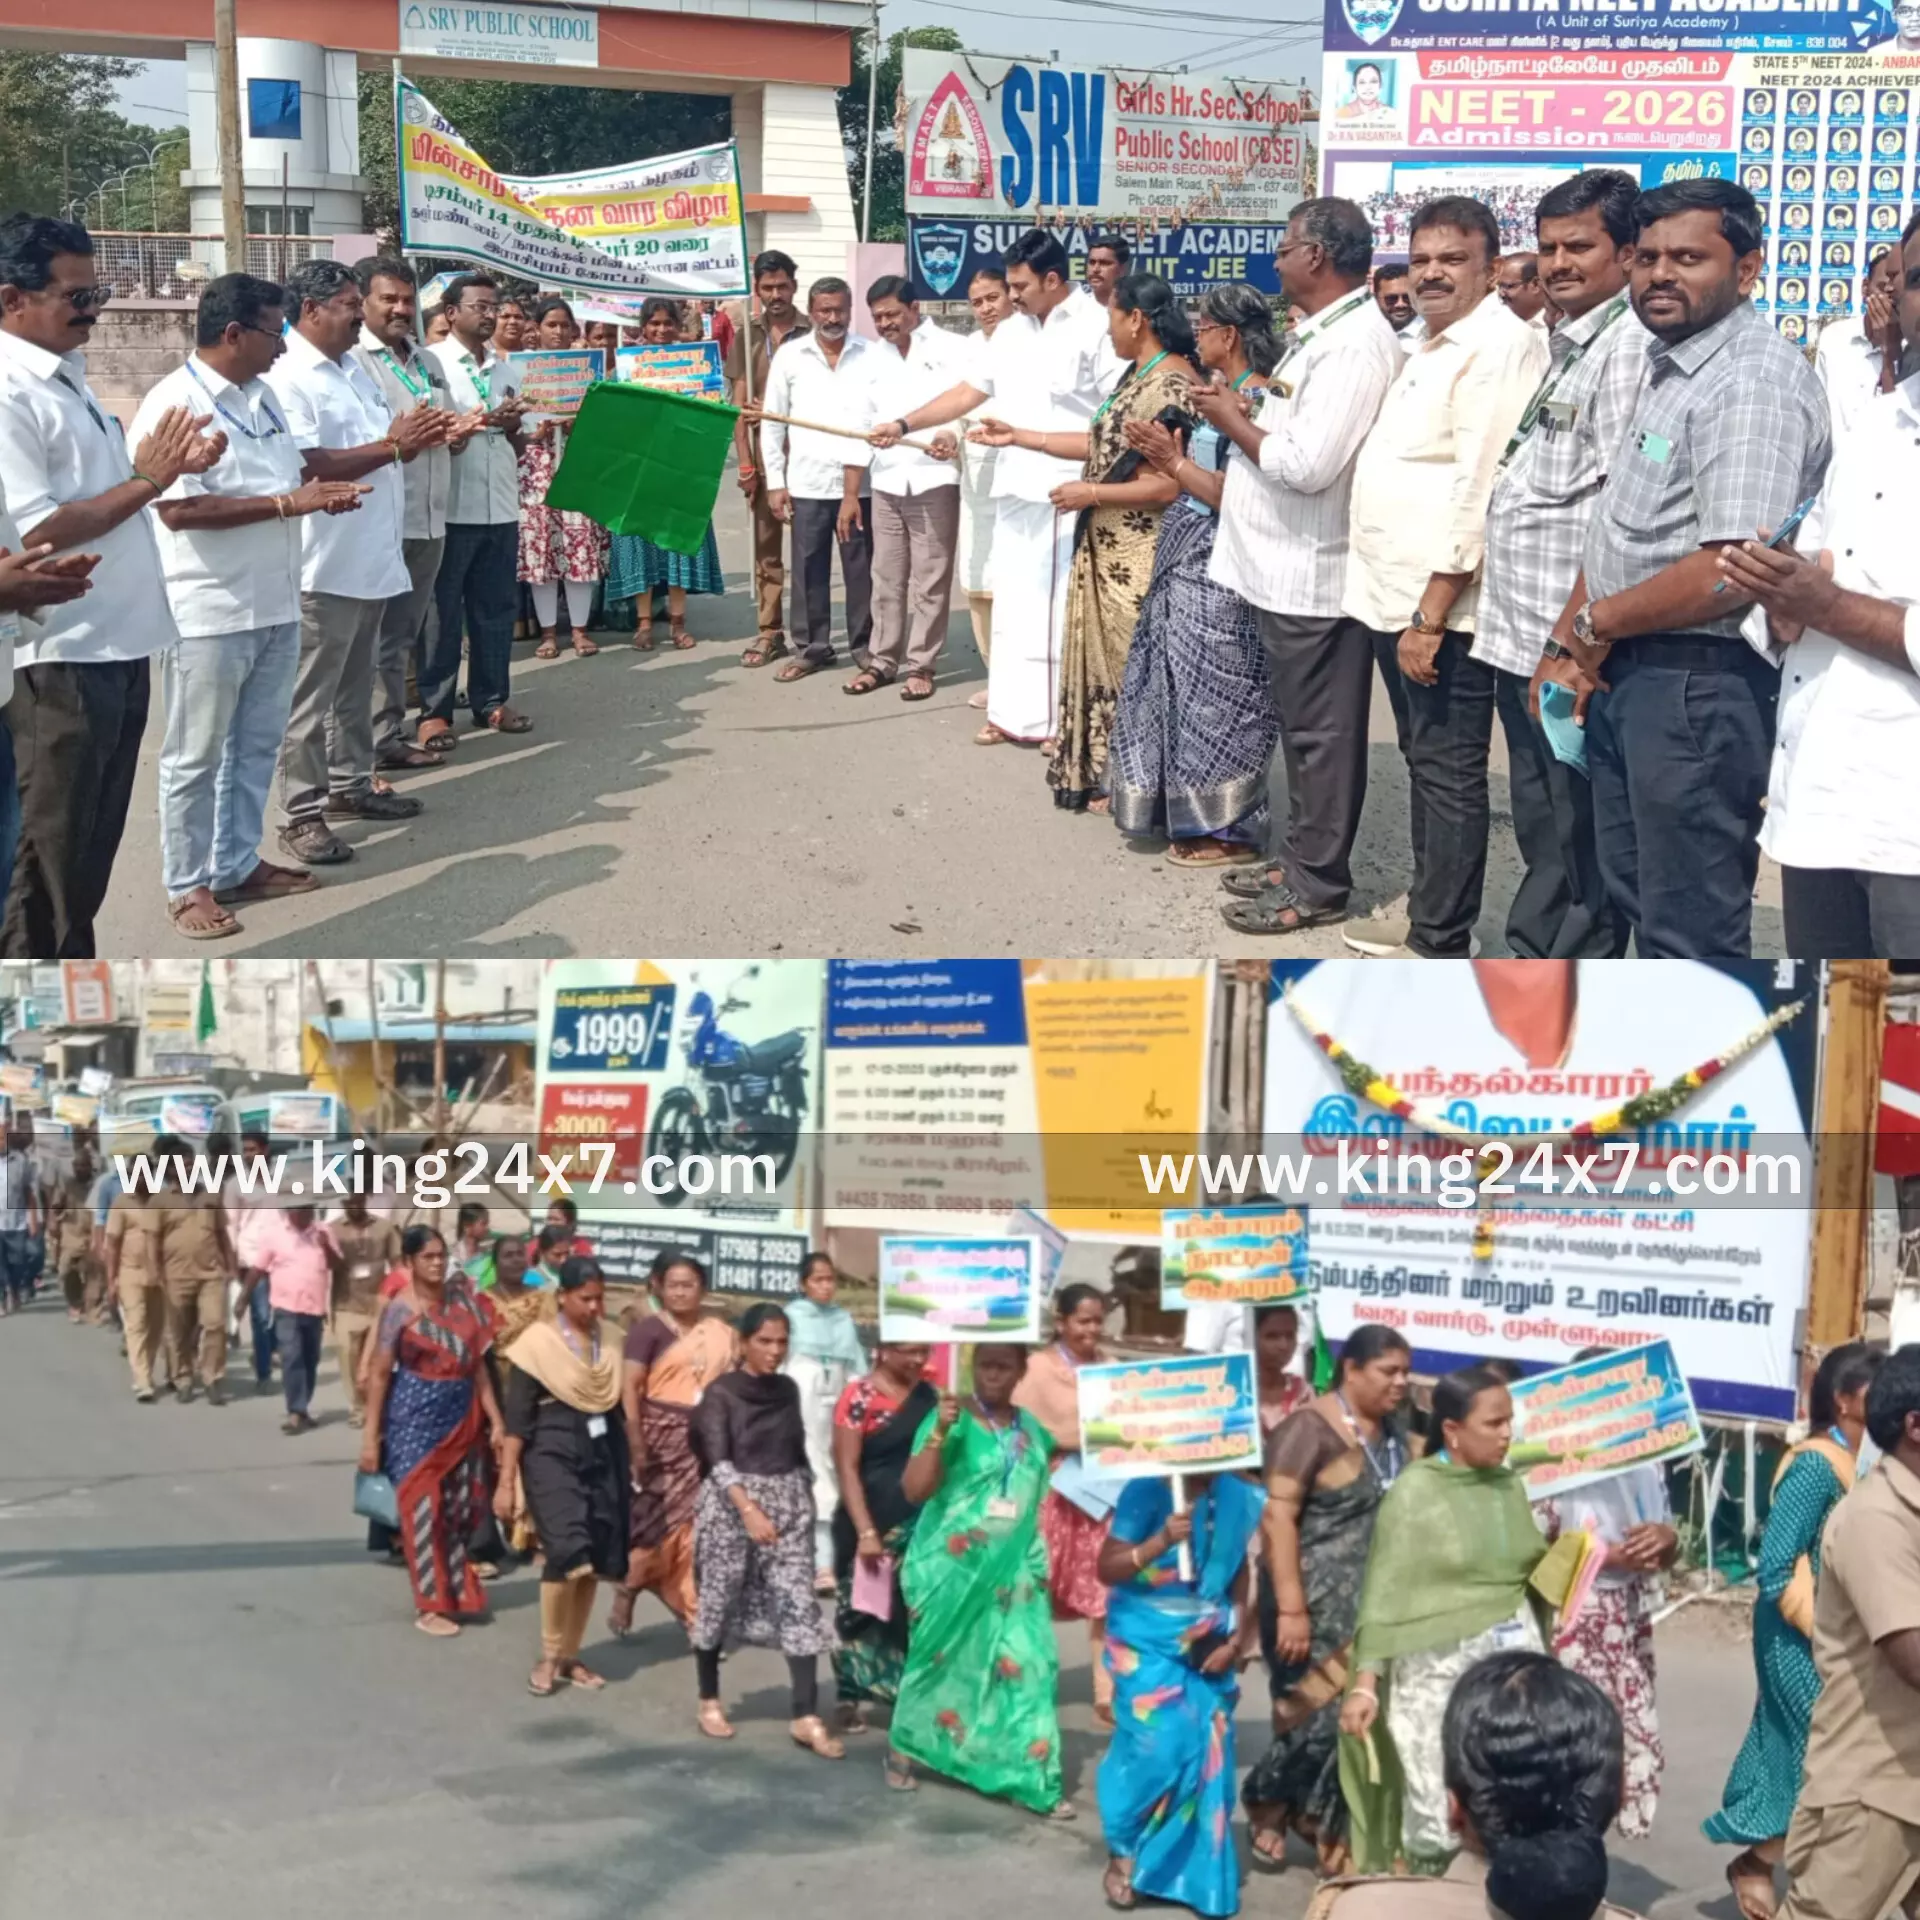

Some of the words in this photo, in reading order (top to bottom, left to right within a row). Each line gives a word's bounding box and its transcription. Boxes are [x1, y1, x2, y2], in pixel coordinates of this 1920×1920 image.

[428, 7, 461, 31] SRV
[464, 9, 525, 36] PUBLIC
[528, 14, 595, 42] SCHOOL
[1546, 17, 1556, 27] A
[1562, 16, 1588, 27] Unit
[1594, 16, 1608, 27] of
[1614, 15, 1657, 30] Suriya
[1662, 14, 1728, 30] Academy
[1438, 38, 1457, 47] ENT
[1460, 38, 1484, 47] CARE
[1428, 55, 1616, 79] தமிழ்நாட்டிலேயே
[1621, 55, 1721, 79] முதலிடம்
[1752, 56, 1789, 69] STATE
[1810, 56, 1843, 69] NEET
[1845, 57, 1872, 69] 2024
[1760, 75, 1799, 86] NEET
[1802, 75, 1842, 86] 2024
[1115, 81, 1166, 115] Girls
[1420, 90, 1556, 125] NEET
[1571, 106, 1586, 117] -
[1602, 90, 1726, 126] 2026
[914, 101, 938, 160] SMART
[1000, 65, 1106, 209] SRV
[1416, 126, 1609, 146] Admission
[1115, 127, 1173, 158] Public
[1180, 130, 1238, 162] School
[1242, 135, 1301, 166] (CBSE)
[411, 132, 507, 198] மின்சார
[601, 198, 657, 227] வார
[663, 190, 729, 227] விழா
[1116, 161, 1168, 173] SENIOR
[1171, 162, 1254, 178] SECONDARY
[934, 183, 972, 194] VIBRANT
[1115, 176, 1147, 188] Salem
[1149, 177, 1173, 189] Main
[1207, 180, 1255, 194] Rsipuram
[1128, 193, 1146, 206] Ph:
[424, 184, 484, 216] டிசம்பர்
[488, 207, 509, 226] 14
[513, 219, 567, 243] முதல்
[635, 239, 660, 256] 20
[665, 237, 710, 253] வரை
[513, 238, 588, 264] நாமக்கல்
[692, 253, 740, 270] வட்டம்
[1179, 228, 1282, 255] ACADEM
[483, 241, 571, 275] இராசிபுரம்
[575, 267, 650, 285] கோட்டம்
[1199, 258, 1247, 280] JEE
[1385, 1065, 1655, 1101] பந்தல்காரர்
[1631, 1208, 1695, 1233] கட்சி
[1308, 1259, 1452, 1298] டும்பத்தினர்
[1461, 1273, 1554, 1314] மற்றும்
[1567, 1286, 1775, 1327] உறவினர்கள்
